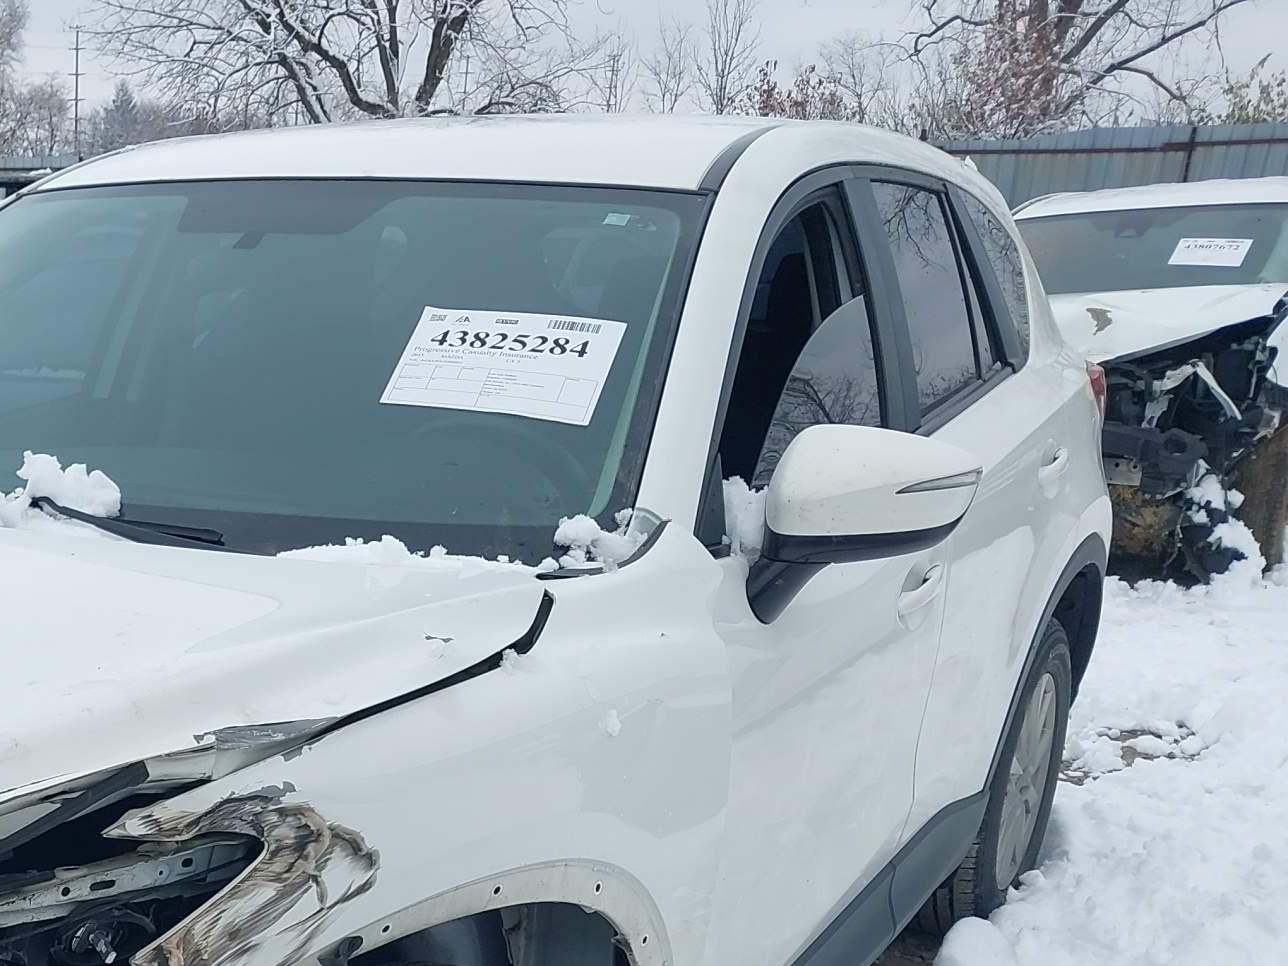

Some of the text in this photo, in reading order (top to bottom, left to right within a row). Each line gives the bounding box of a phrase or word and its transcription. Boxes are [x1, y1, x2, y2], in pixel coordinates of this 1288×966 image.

[414, 345, 539, 360] Progressive Casualty Insurance
[430, 329, 591, 358] 43825284
